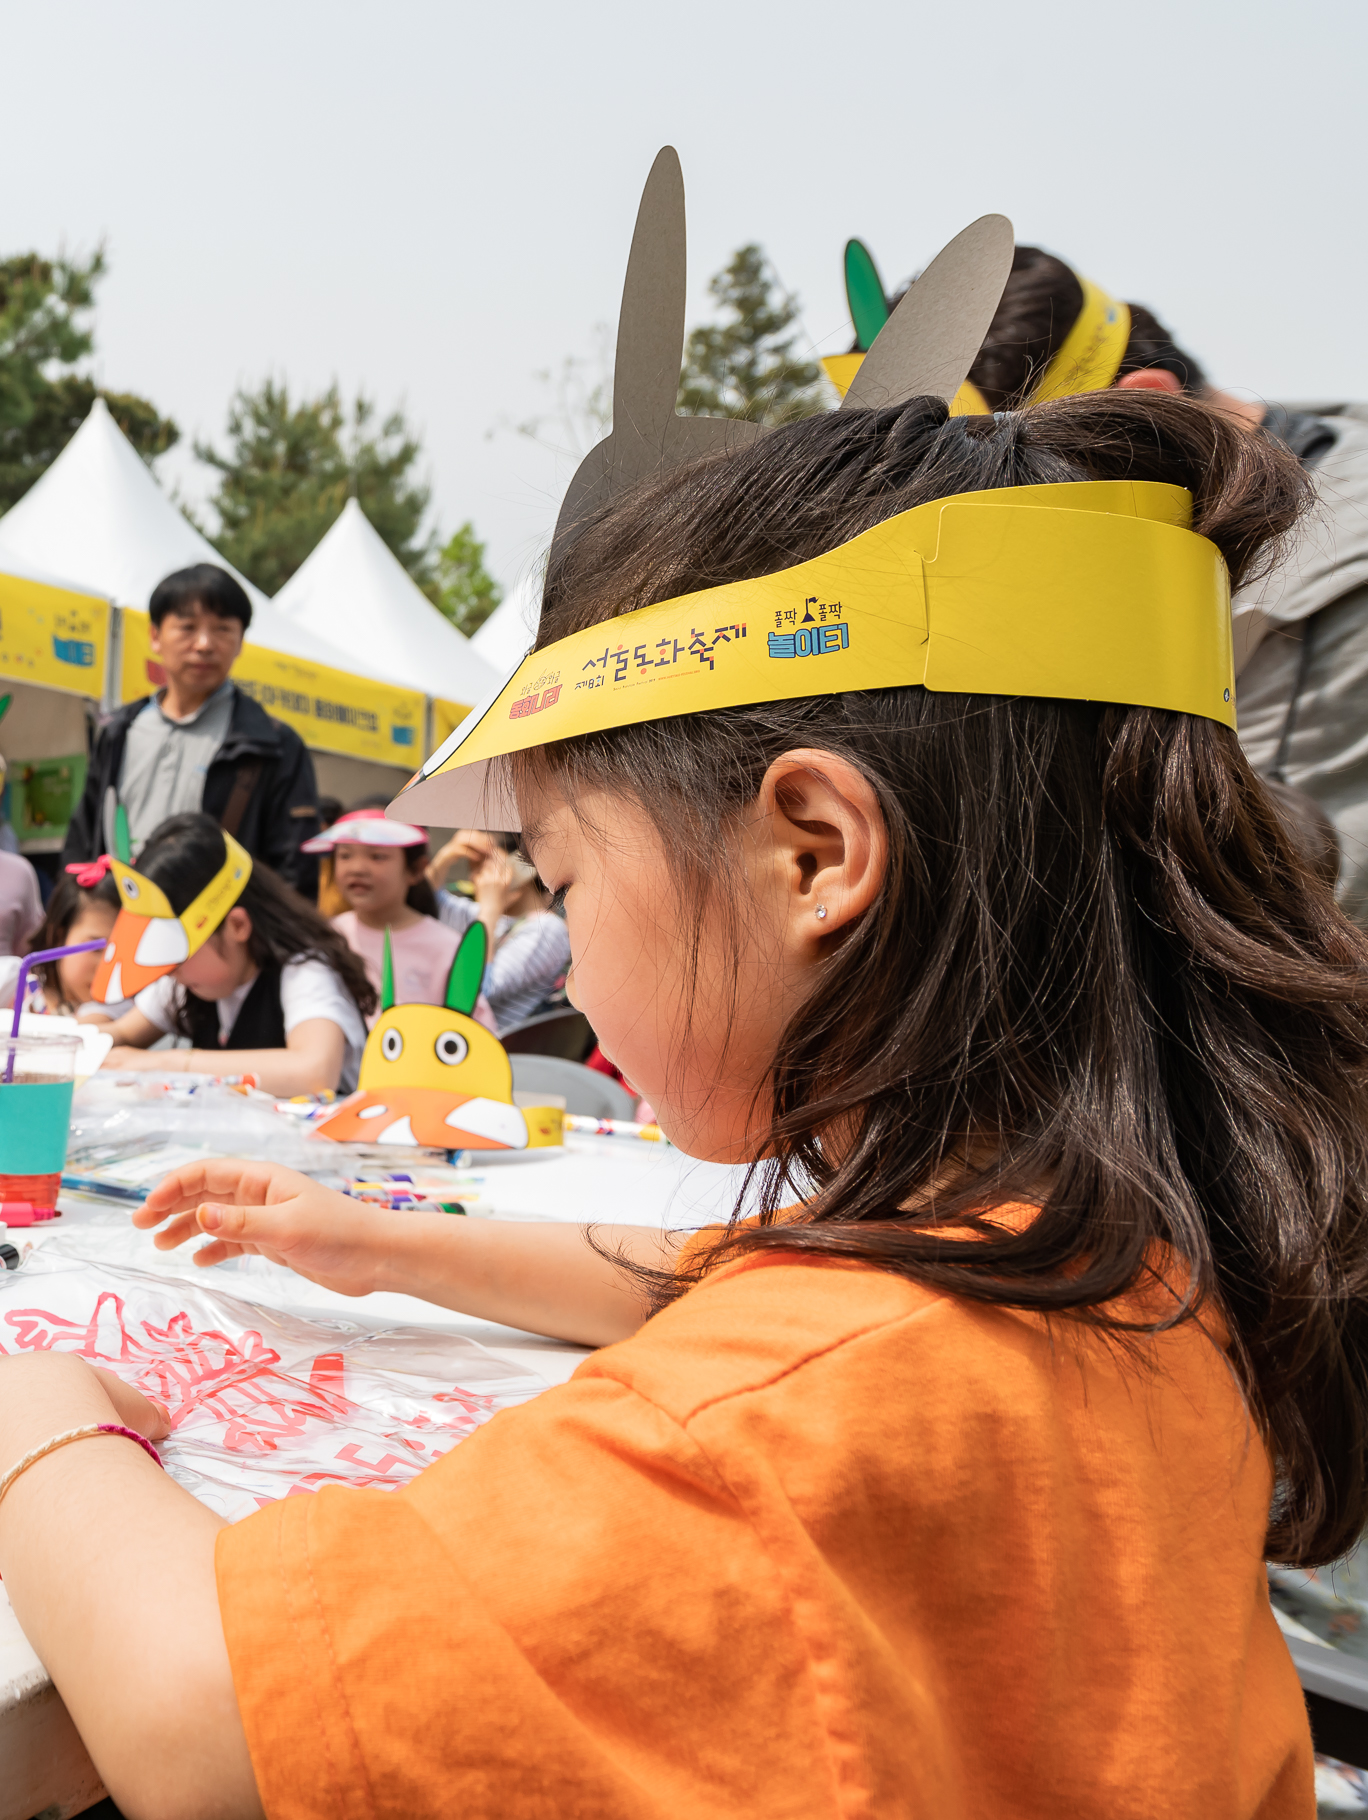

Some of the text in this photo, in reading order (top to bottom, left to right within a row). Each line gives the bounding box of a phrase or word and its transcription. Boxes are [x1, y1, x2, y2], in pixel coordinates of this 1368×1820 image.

[775, 601, 842, 628] 폴짝 폴짝
[582, 622, 747, 681] 서울동화축제
[767, 622, 849, 658] 놀이터
[574, 675, 605, 691] 제8회
[509, 684, 563, 719] 동화나라
